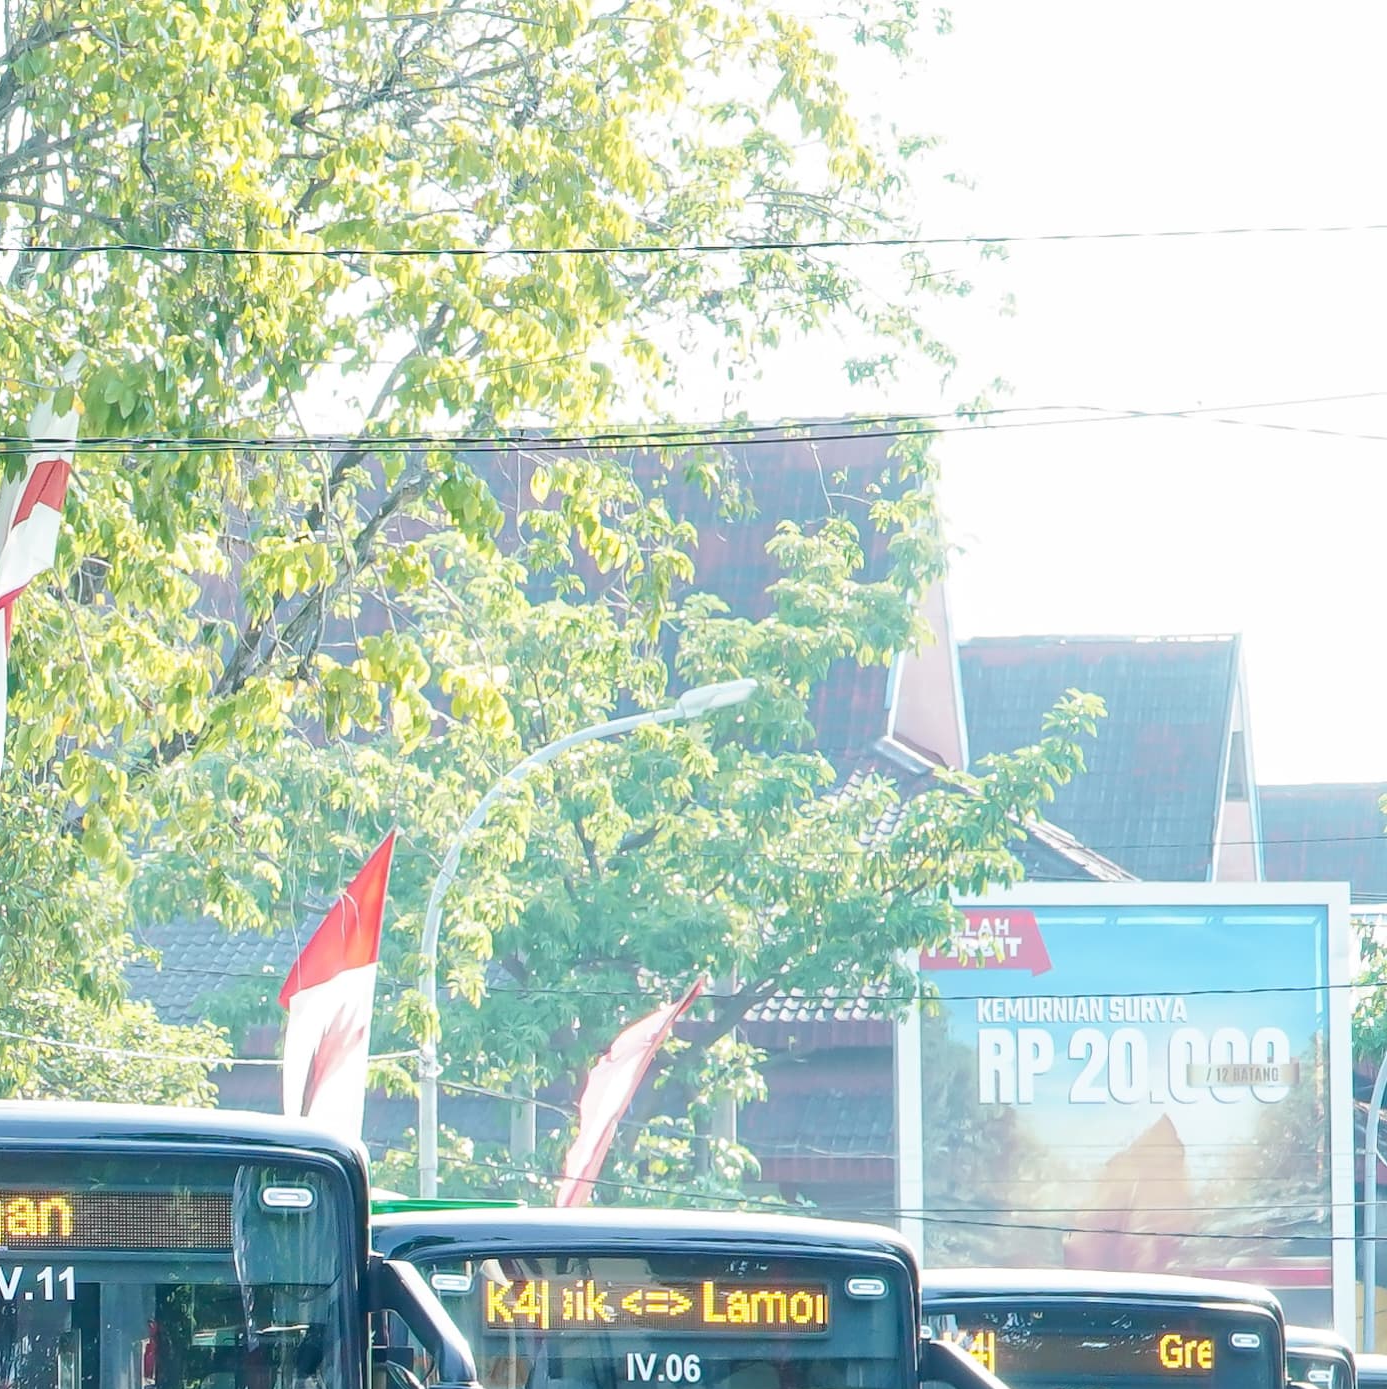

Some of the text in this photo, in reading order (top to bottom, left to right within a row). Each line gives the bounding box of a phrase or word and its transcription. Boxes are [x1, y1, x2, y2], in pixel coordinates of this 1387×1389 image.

[977, 997, 1188, 1023] KEMURNIAN SURYA
[977, 1028, 1291, 1104] RP 20.000
[627, 1353, 702, 1382] IV.06
